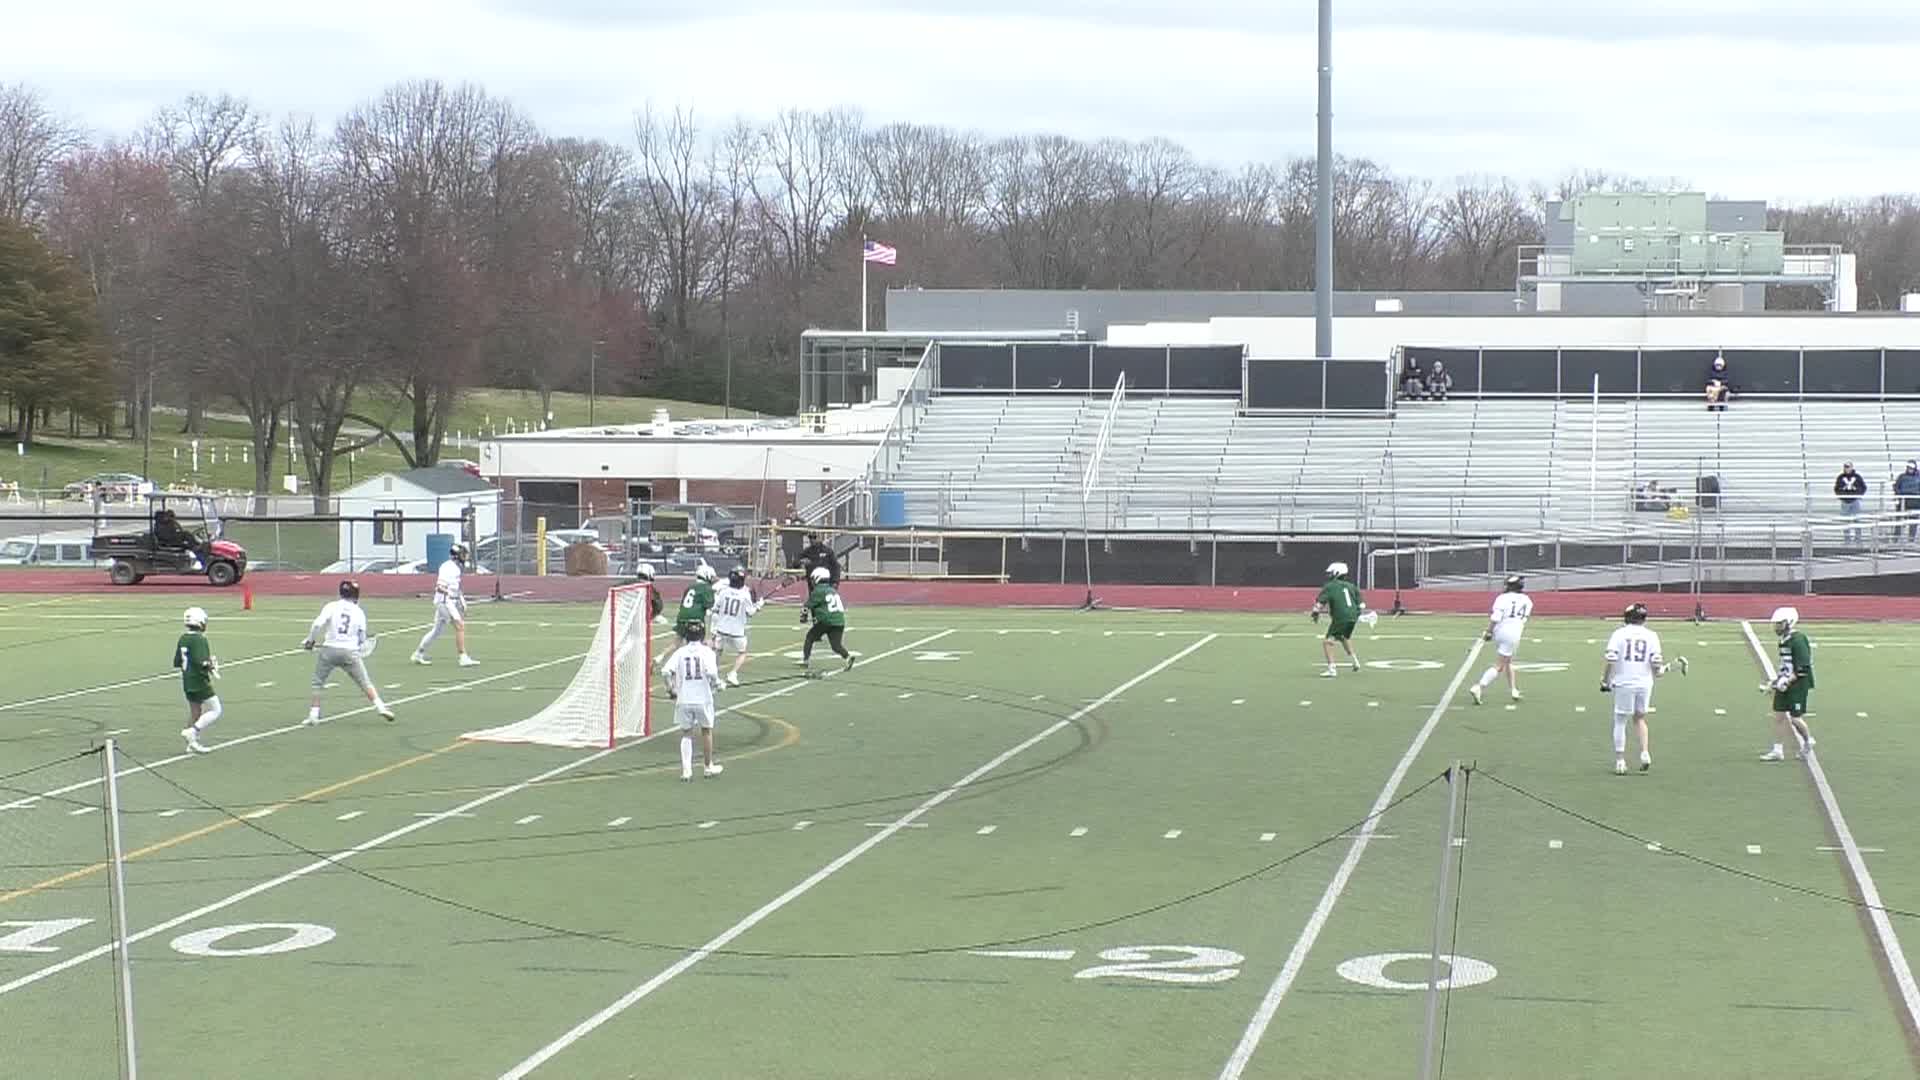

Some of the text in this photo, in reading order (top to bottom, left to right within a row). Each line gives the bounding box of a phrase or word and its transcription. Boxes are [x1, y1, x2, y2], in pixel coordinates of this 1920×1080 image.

[683, 589, 696, 608] 6
[724, 596, 740, 616] 10
[1342, 587, 1352, 607] 1
[1509, 601, 1528, 619] 14
[338, 613, 351, 634] 3
[1624, 638, 1647, 662] 19
[684, 656, 702, 680] 11
